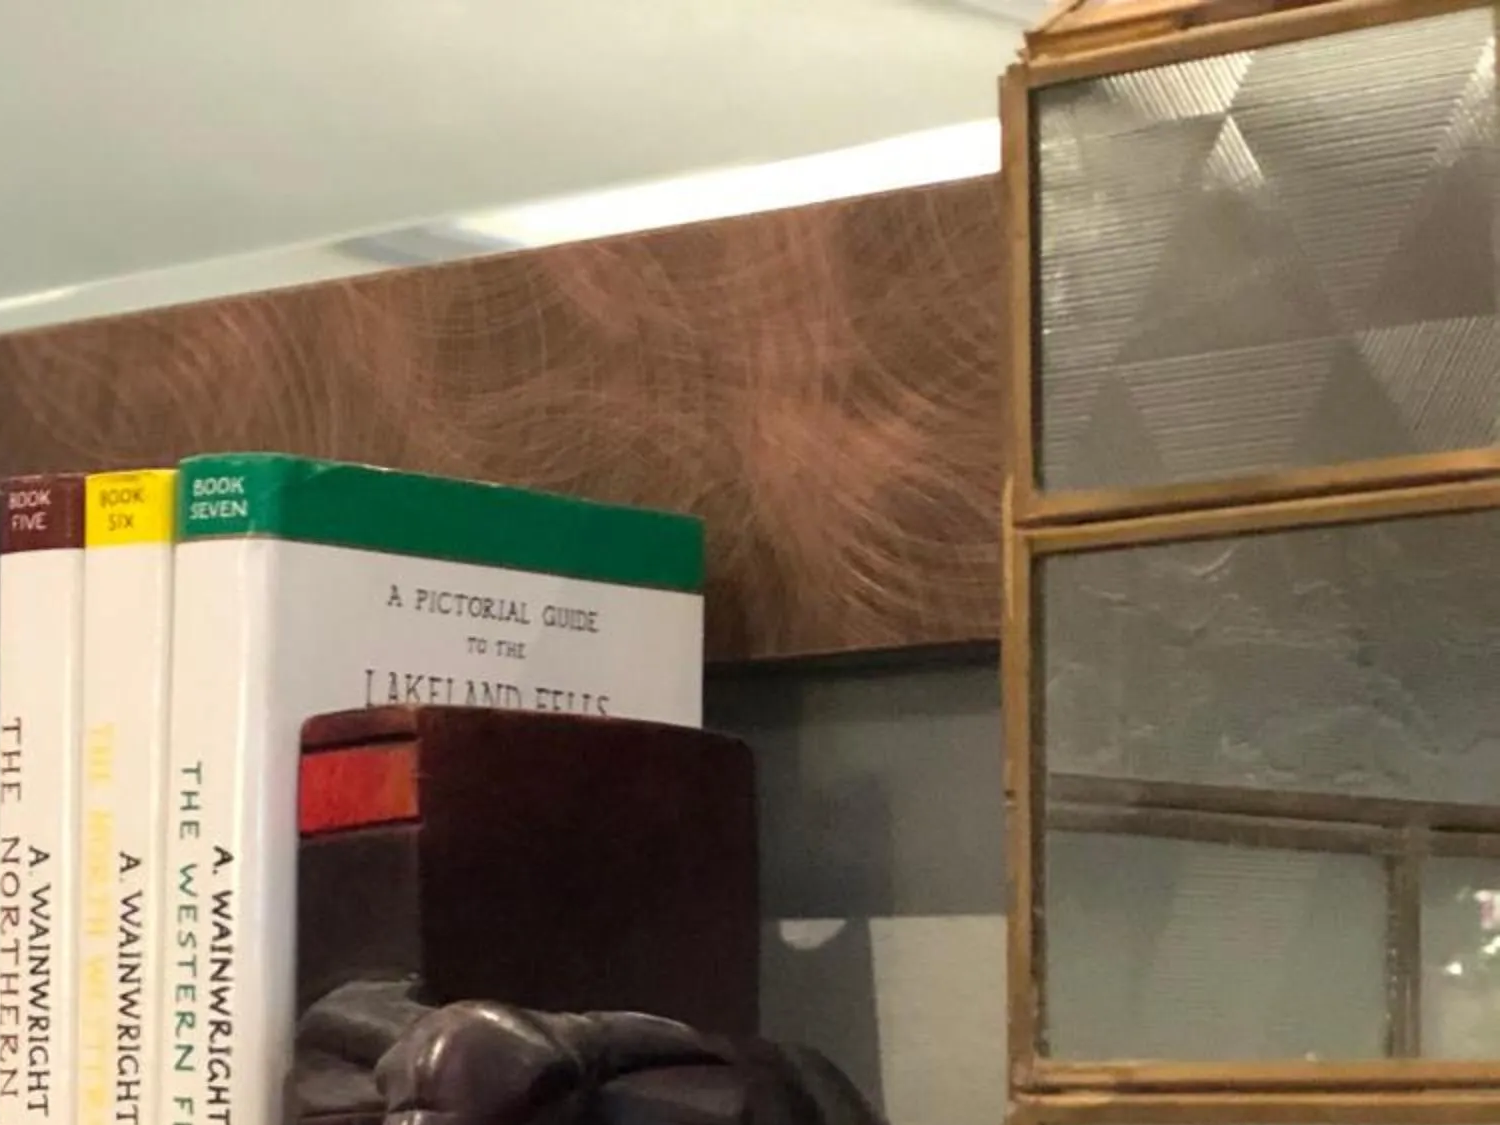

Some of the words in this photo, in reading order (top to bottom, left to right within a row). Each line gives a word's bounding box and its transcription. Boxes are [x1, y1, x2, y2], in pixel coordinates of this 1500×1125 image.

[192, 476, 245, 497] BOOK
[9, 489, 51, 509] BOOK
[189, 499, 248, 520] SEVEN
[11, 513, 47, 532] FIVE
[107, 513, 134, 531] SIX
[387, 584, 404, 608] A
[414, 588, 531, 626] PICTORIAL
[541, 604, 600, 634] GUIDE
[466, 636, 488, 655] TO
[495, 640, 528, 660] THE
[0, 716, 22, 804] THE
[179, 760, 203, 840] THE
[174, 863, 198, 1073] WESTERN
[26, 883, 52, 1117] WAINWRIGHT
